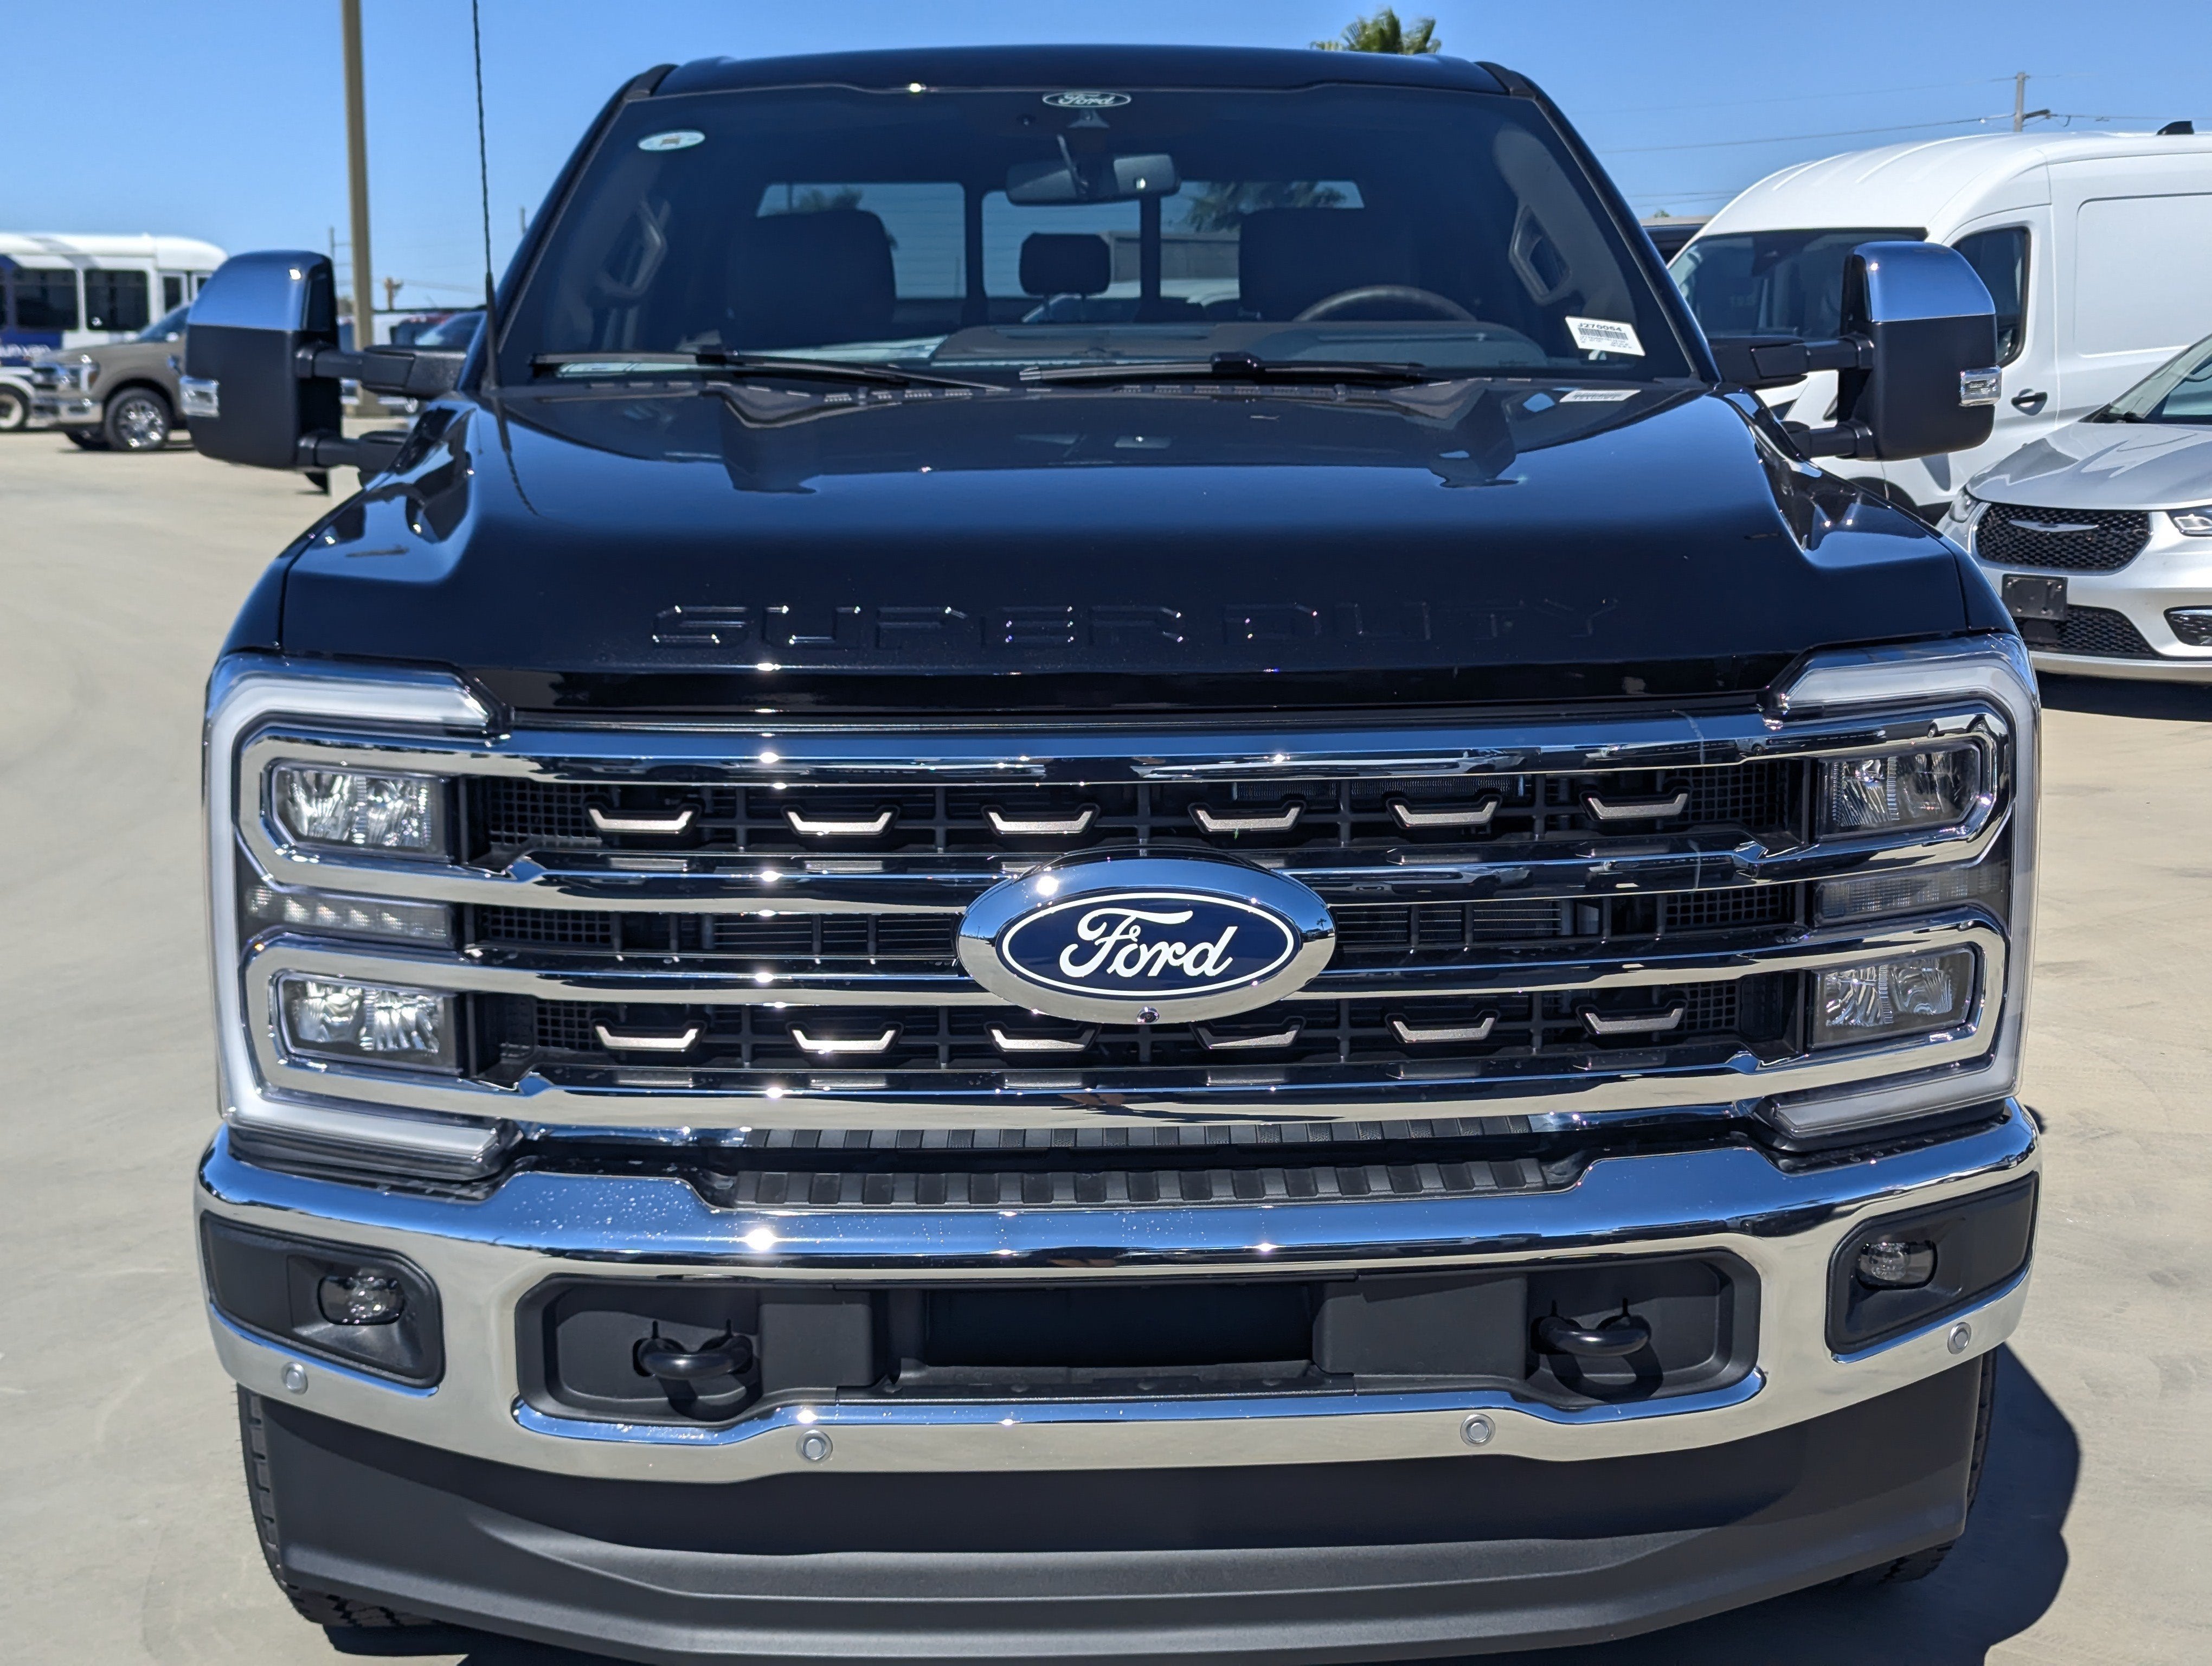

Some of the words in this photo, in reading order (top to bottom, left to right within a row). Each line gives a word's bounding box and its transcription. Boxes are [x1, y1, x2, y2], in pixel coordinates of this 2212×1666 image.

[1058, 92, 1115, 105] Ford
[651, 604, 1191, 649] SUPER
[1221, 598, 1619, 645] DUTY
[1059, 907, 1238, 978] Ford
